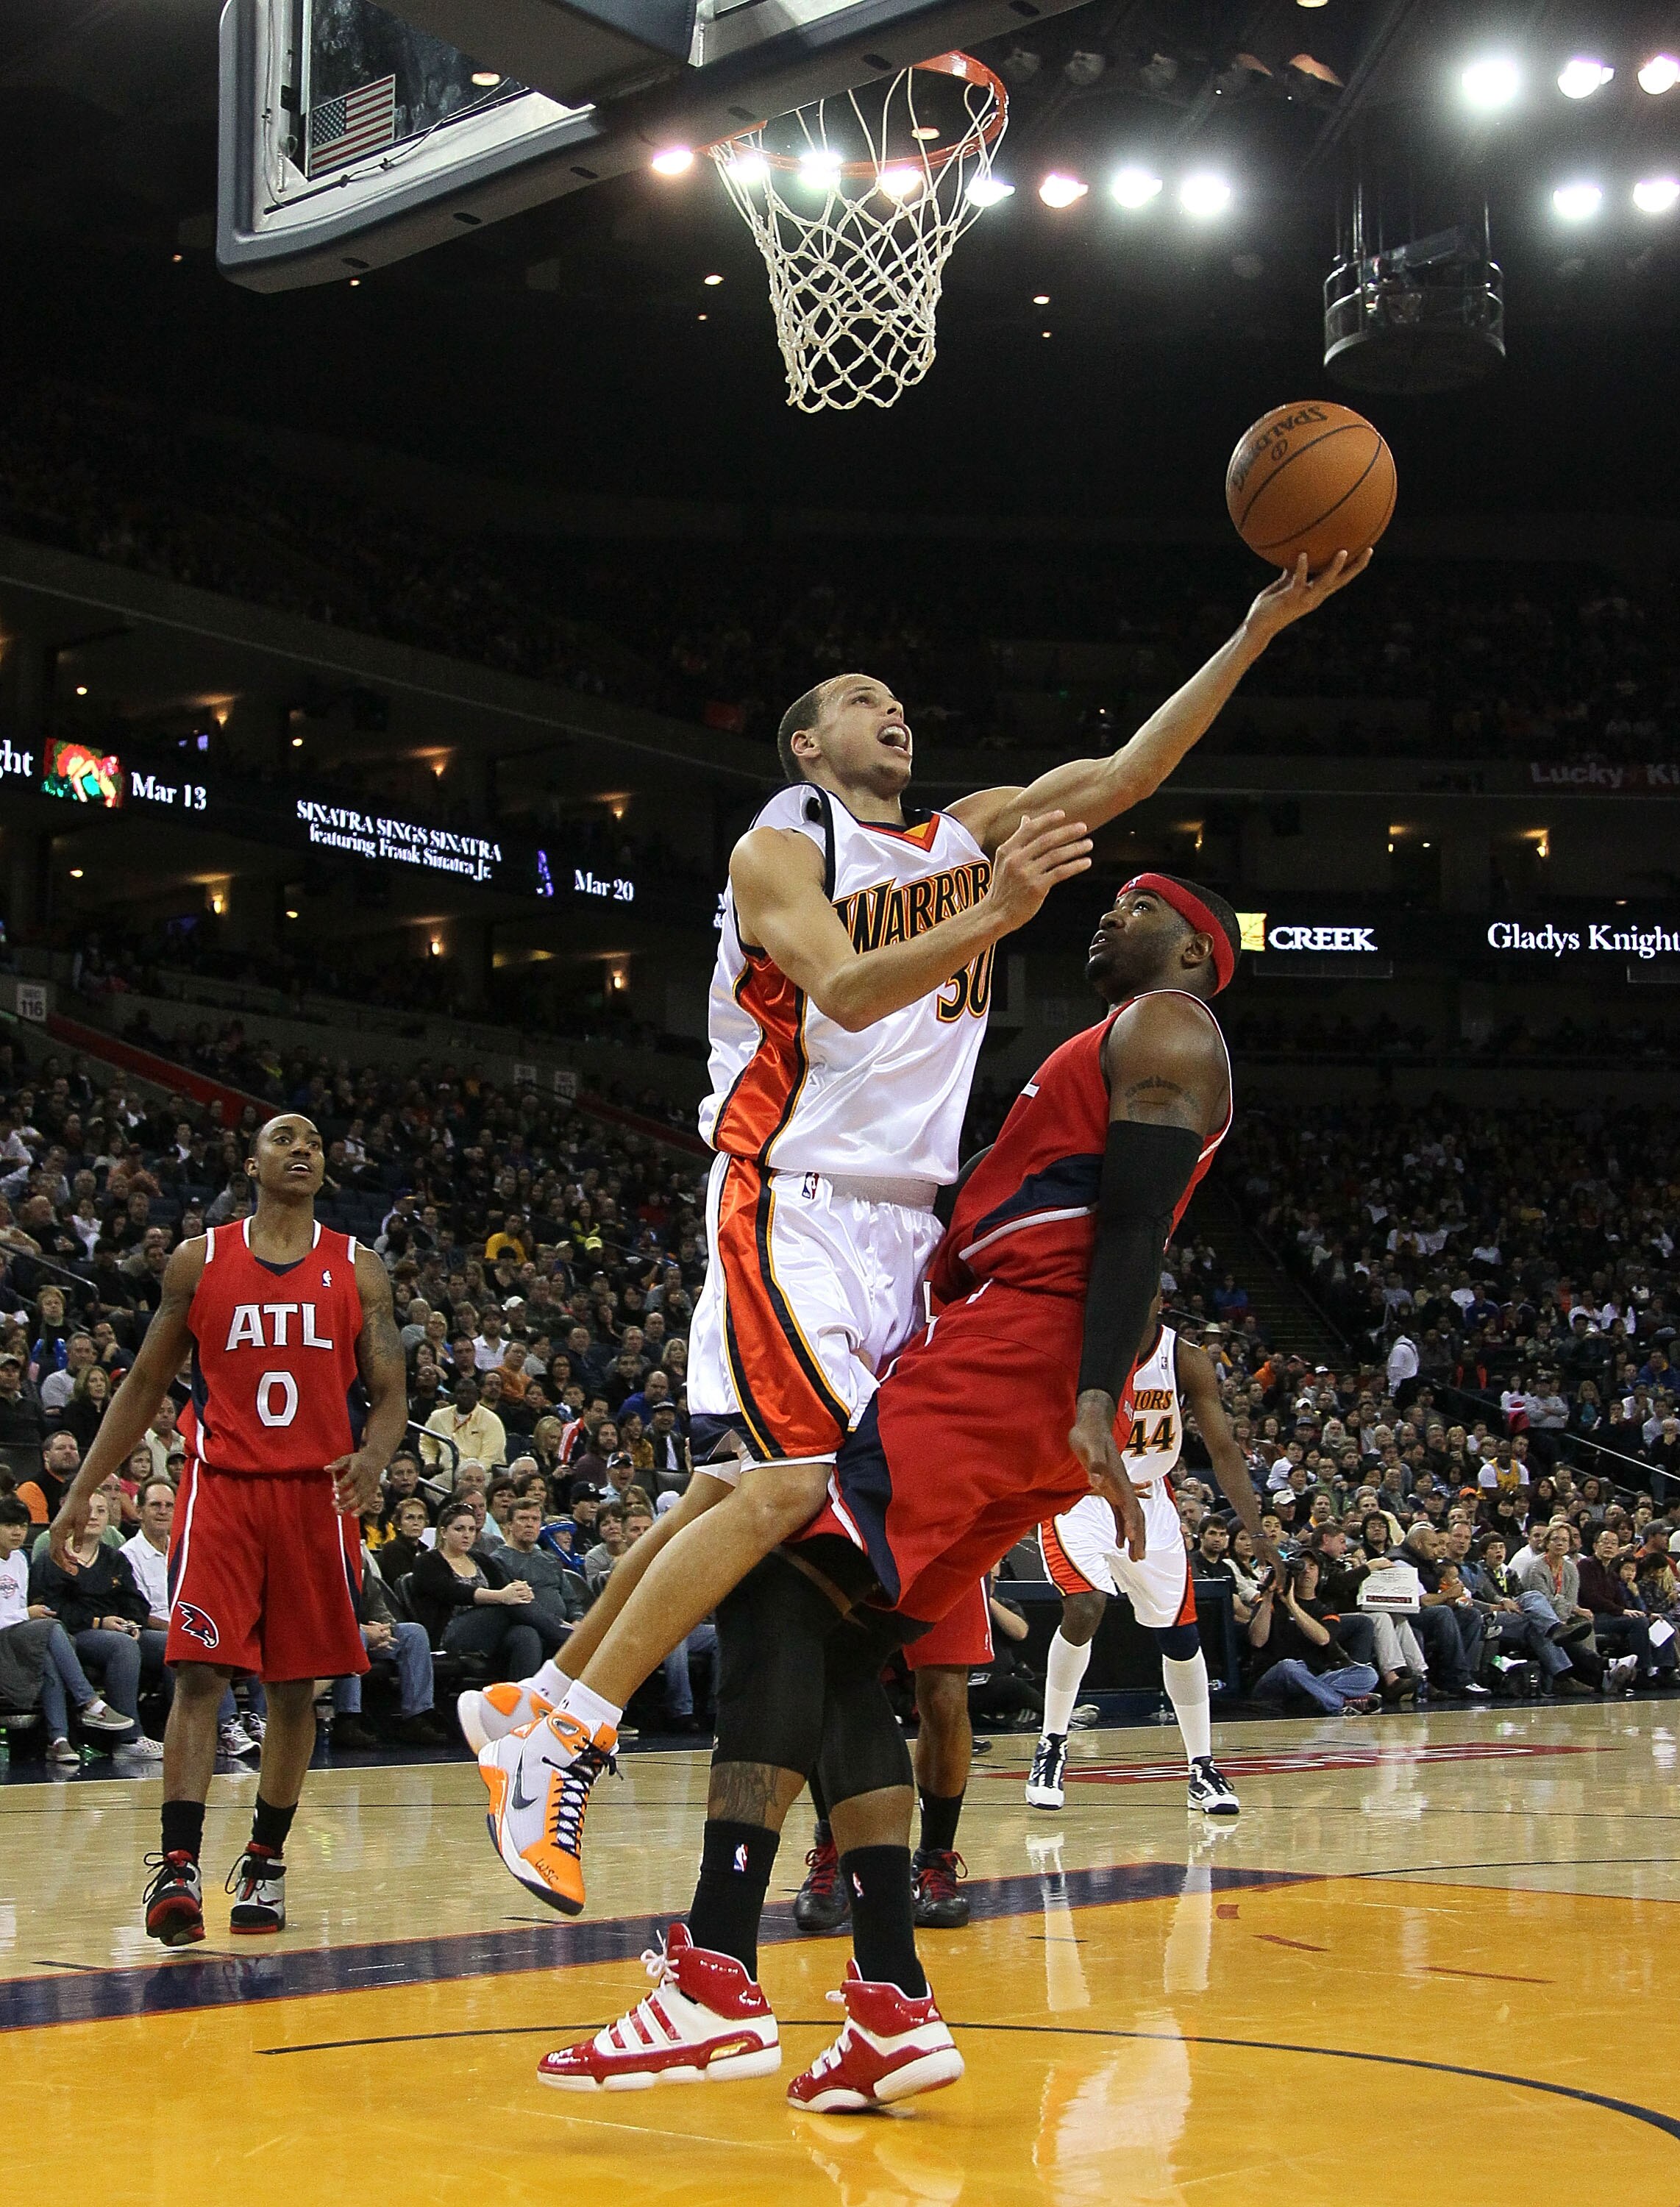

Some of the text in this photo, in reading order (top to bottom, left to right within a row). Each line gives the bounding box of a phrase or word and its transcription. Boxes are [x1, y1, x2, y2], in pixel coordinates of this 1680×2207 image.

[1232, 406, 1328, 492] SPALDG
[132, 771, 207, 810] Mar 13
[1530, 761, 1623, 788] Lucky
[296, 800, 502, 862] SINATRA SINGS SINATRA
[310, 822, 492, 881] featuring Frank Sinatra Jr.
[574, 869, 634, 901] Mar 20
[1268, 925, 1378, 951] CREEK
[1487, 923, 1680, 959] Gladys Knight
[224, 1302, 334, 1351] ATL
[256, 1371, 299, 1427] 0
[1124, 1414, 1176, 1458] 44
